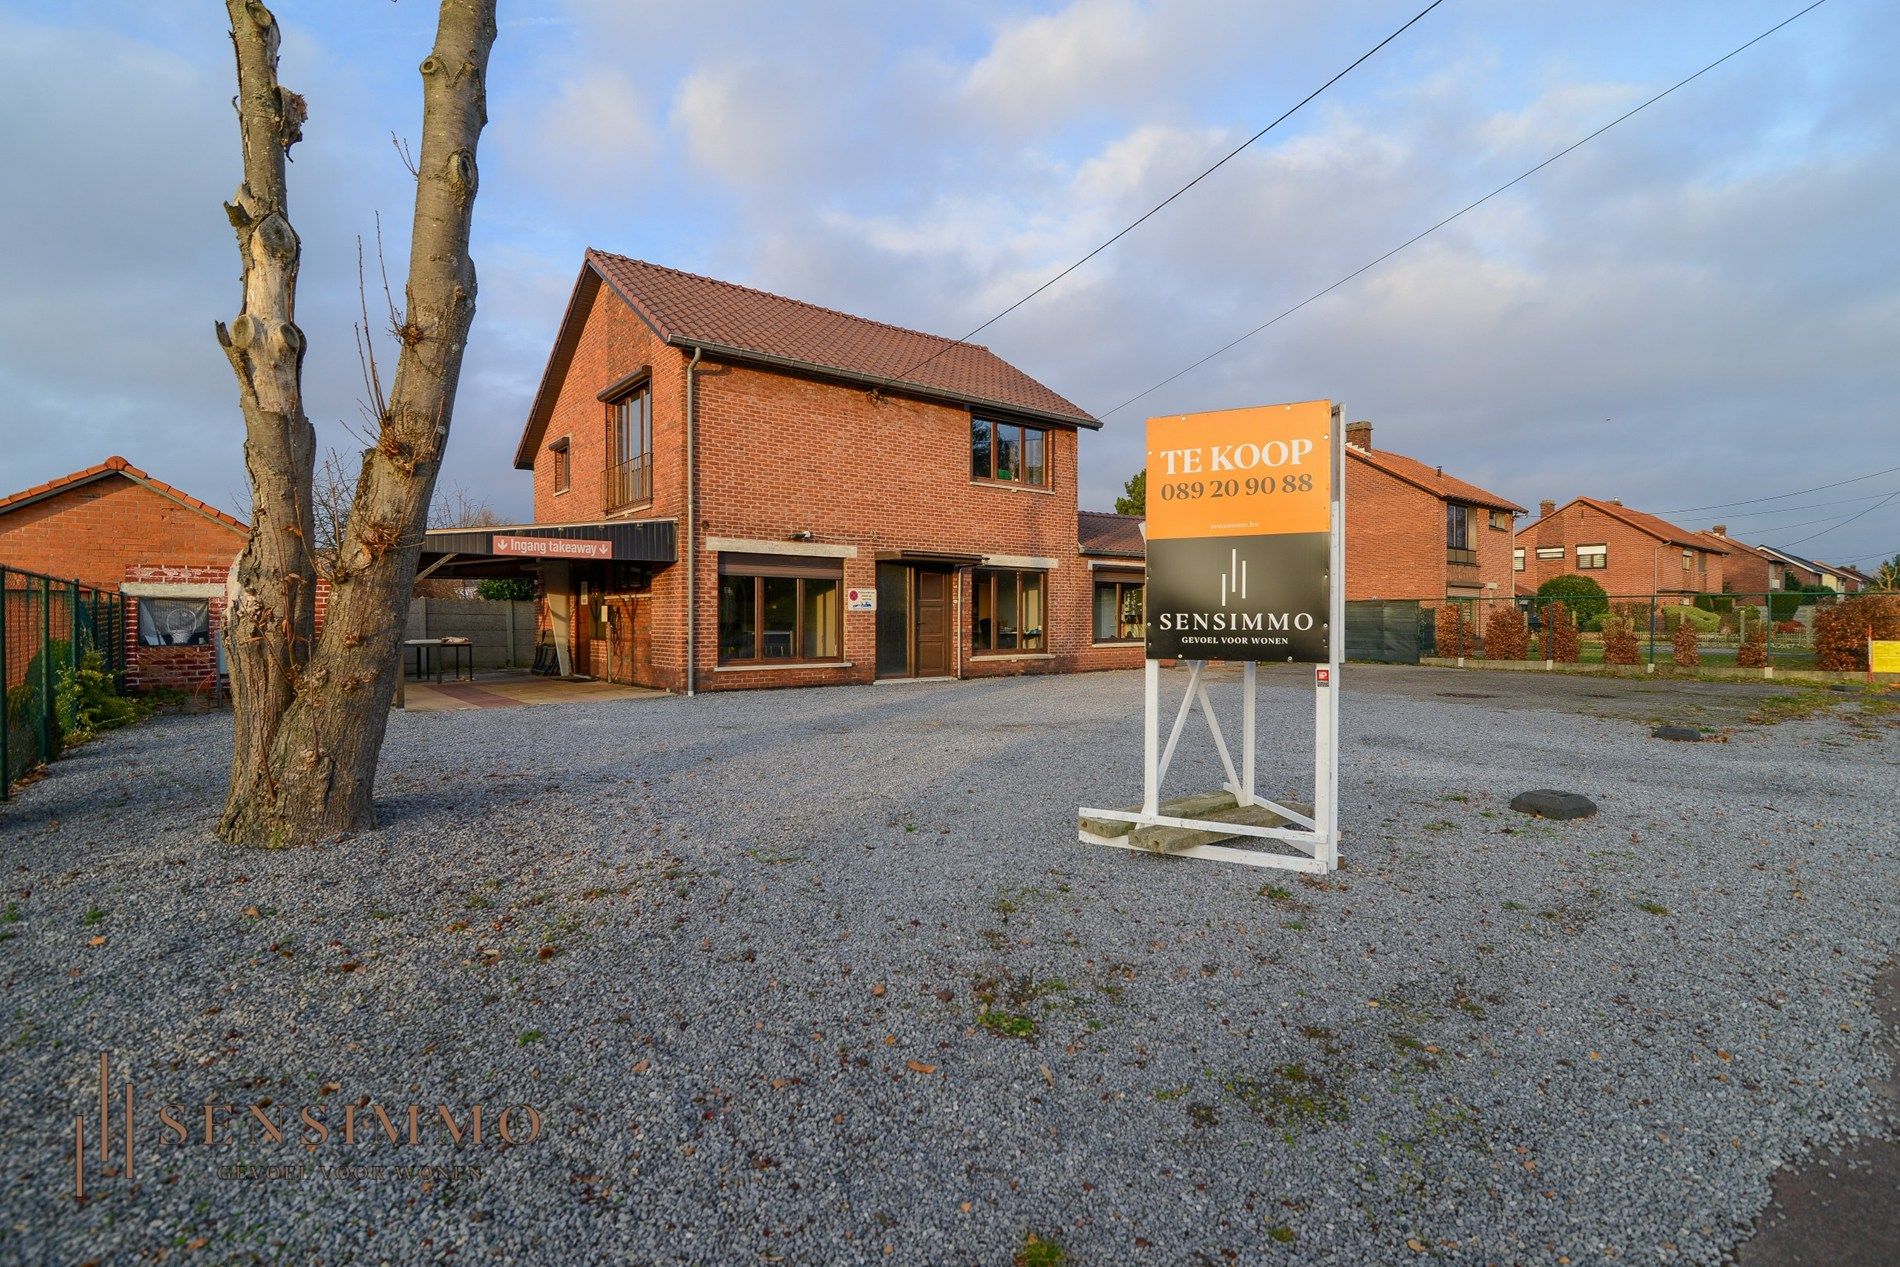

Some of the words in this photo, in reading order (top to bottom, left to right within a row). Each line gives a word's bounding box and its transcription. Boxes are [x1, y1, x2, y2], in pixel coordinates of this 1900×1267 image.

[1160, 448, 1202, 475] TE
[1210, 438, 1313, 472] KOOP
[1161, 481, 1204, 501] 089
[1210, 479, 1239, 498] 20
[1245, 476, 1276, 496] 90
[1281, 473, 1313, 493] 88
[510, 538, 546, 554] Ingang
[549, 541, 597, 556] takeaway
[1159, 612, 1314, 631] SENSIMMO
[1181, 636, 1218, 644] GEVOEL
[1221, 637, 1248, 645] VOOR
[1251, 637, 1288, 645] WONEN
